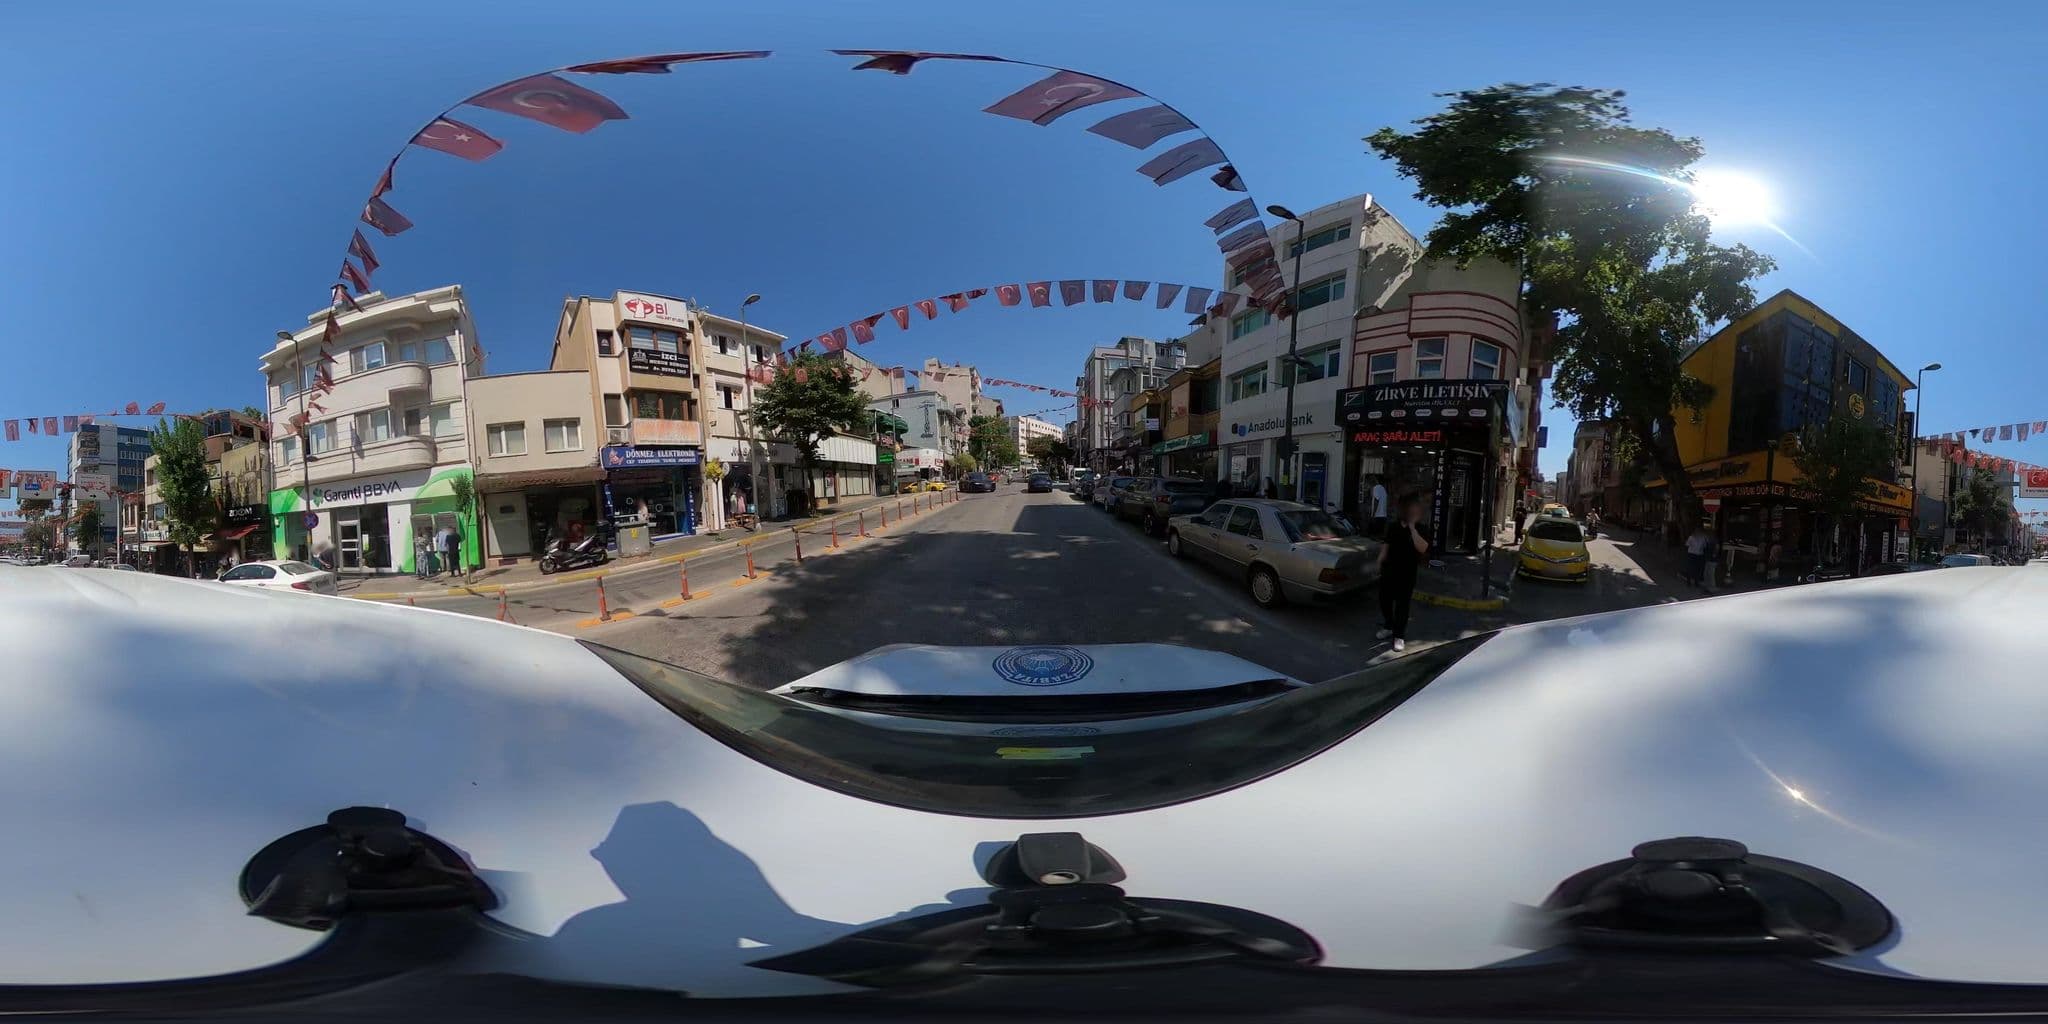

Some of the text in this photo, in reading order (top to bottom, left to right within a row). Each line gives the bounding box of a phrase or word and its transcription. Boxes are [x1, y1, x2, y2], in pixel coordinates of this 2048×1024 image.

[1375, 386, 1420, 401] ZİRVE
[1248, 412, 1313, 433] Anadoluank
[625, 448, 655, 459] DÖNMEZ
[323, 480, 402, 502] Garanti BBVA
